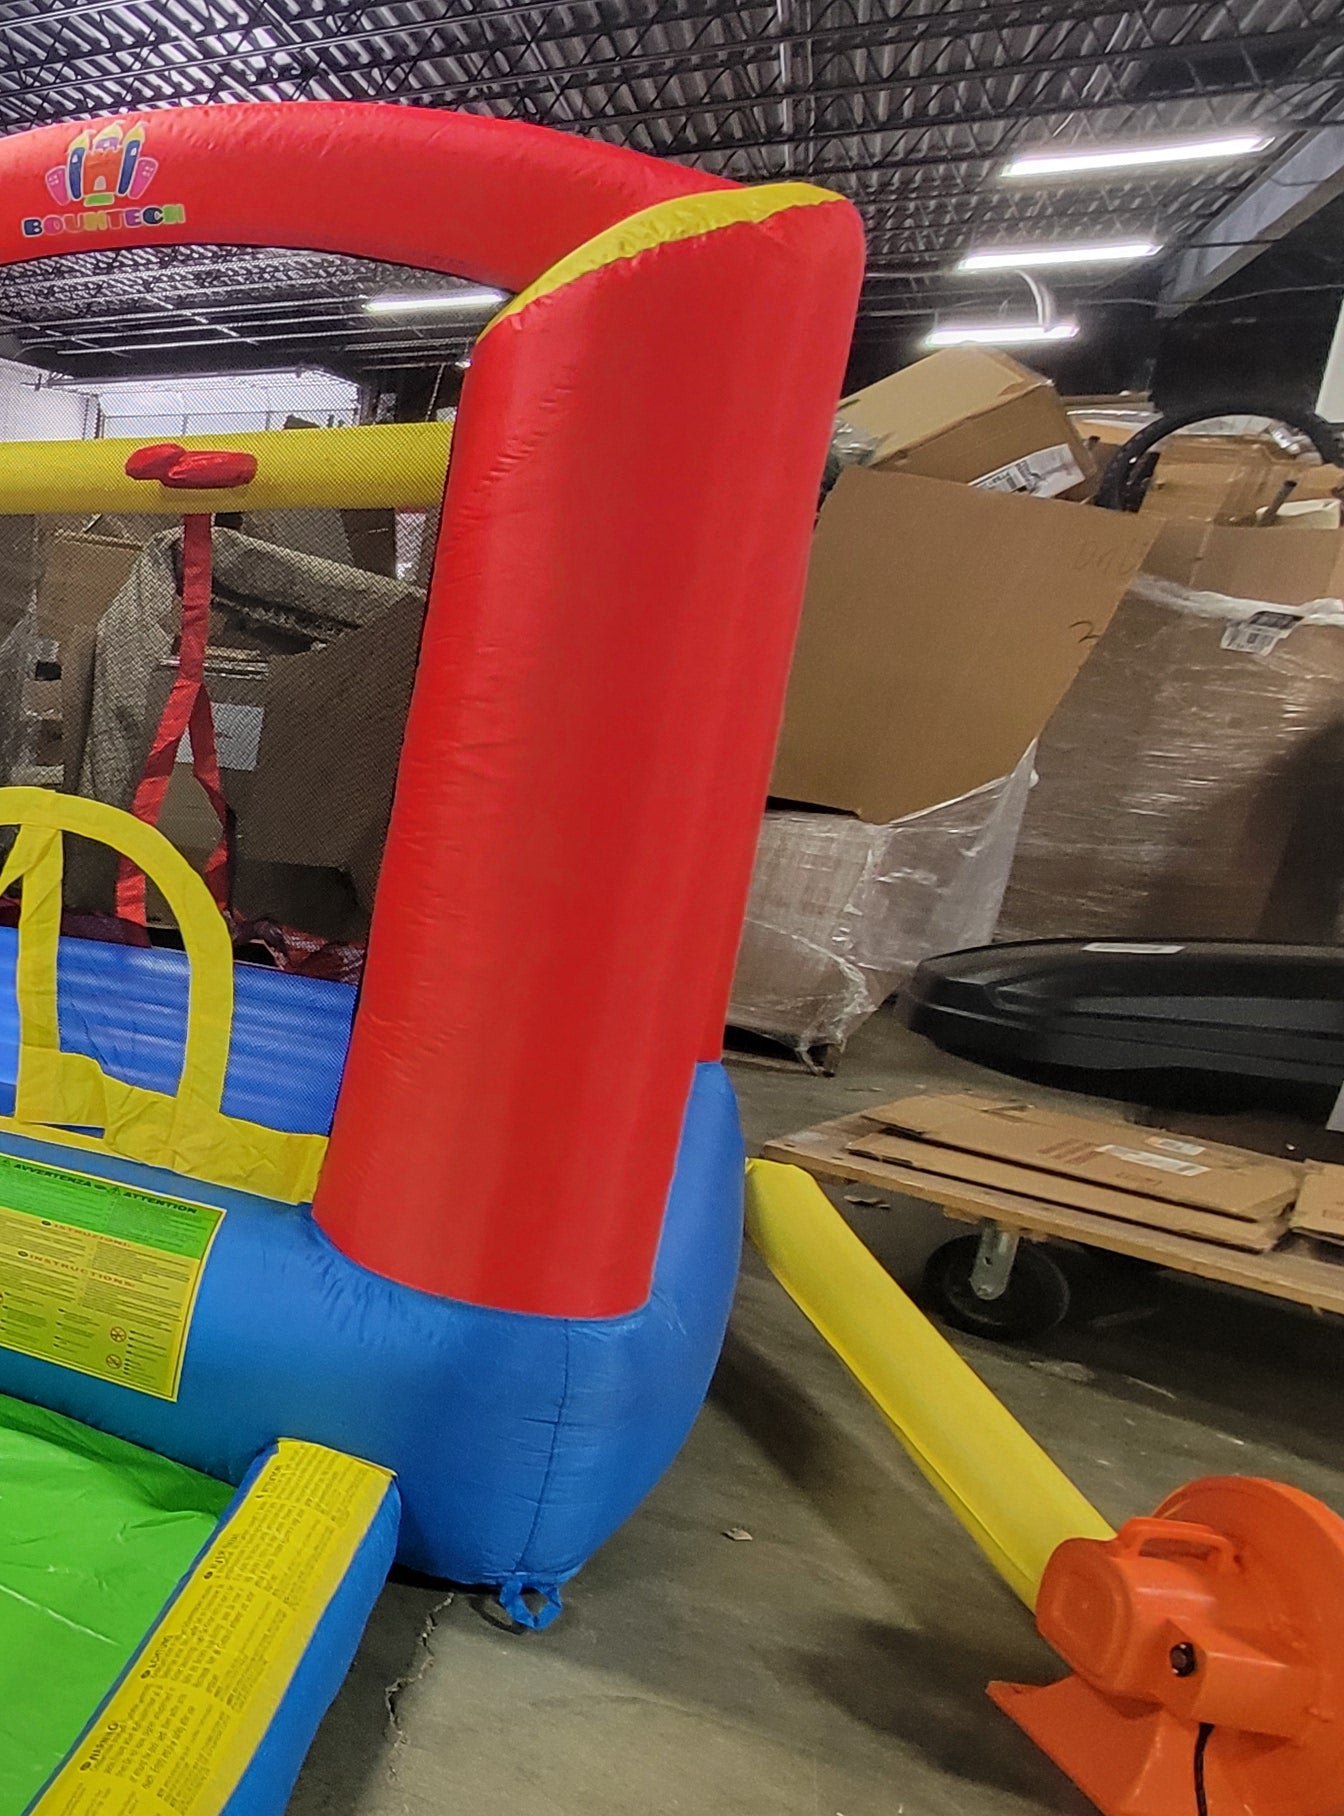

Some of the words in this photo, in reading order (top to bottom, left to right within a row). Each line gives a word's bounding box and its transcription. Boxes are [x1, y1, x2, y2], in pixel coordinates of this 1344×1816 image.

[20, 203, 187, 238] BOUNTECH
[13, 1163, 93, 1188] AVVERTENZA
[122, 1191, 198, 1214] ATTENTION
